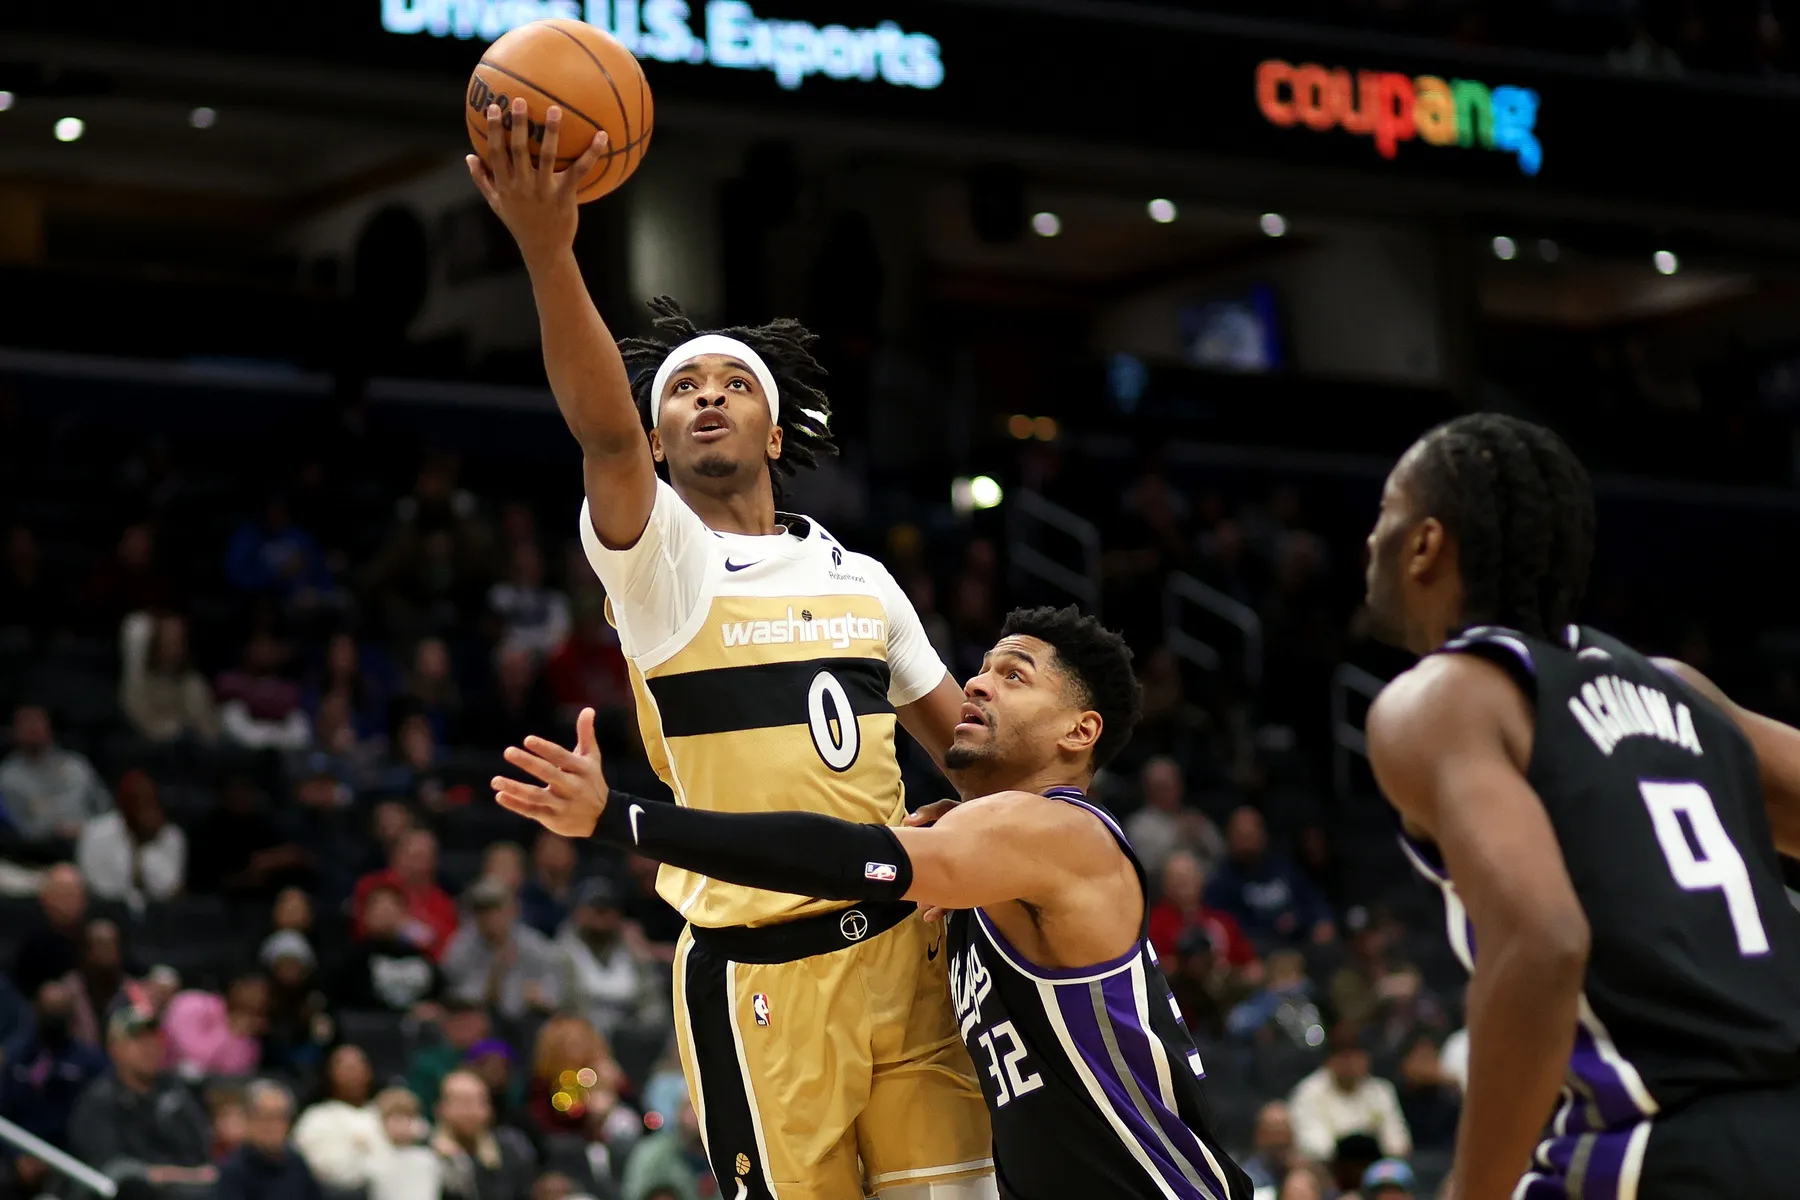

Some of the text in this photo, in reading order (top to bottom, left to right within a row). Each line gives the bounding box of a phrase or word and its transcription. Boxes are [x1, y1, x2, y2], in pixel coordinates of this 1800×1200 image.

[706, 0, 944, 89] Exports
[1256, 60, 1541, 175] coupang
[807, 667, 860, 773] 0
[1638, 779, 1770, 955] 9
[979, 1019, 1044, 1107] 32
